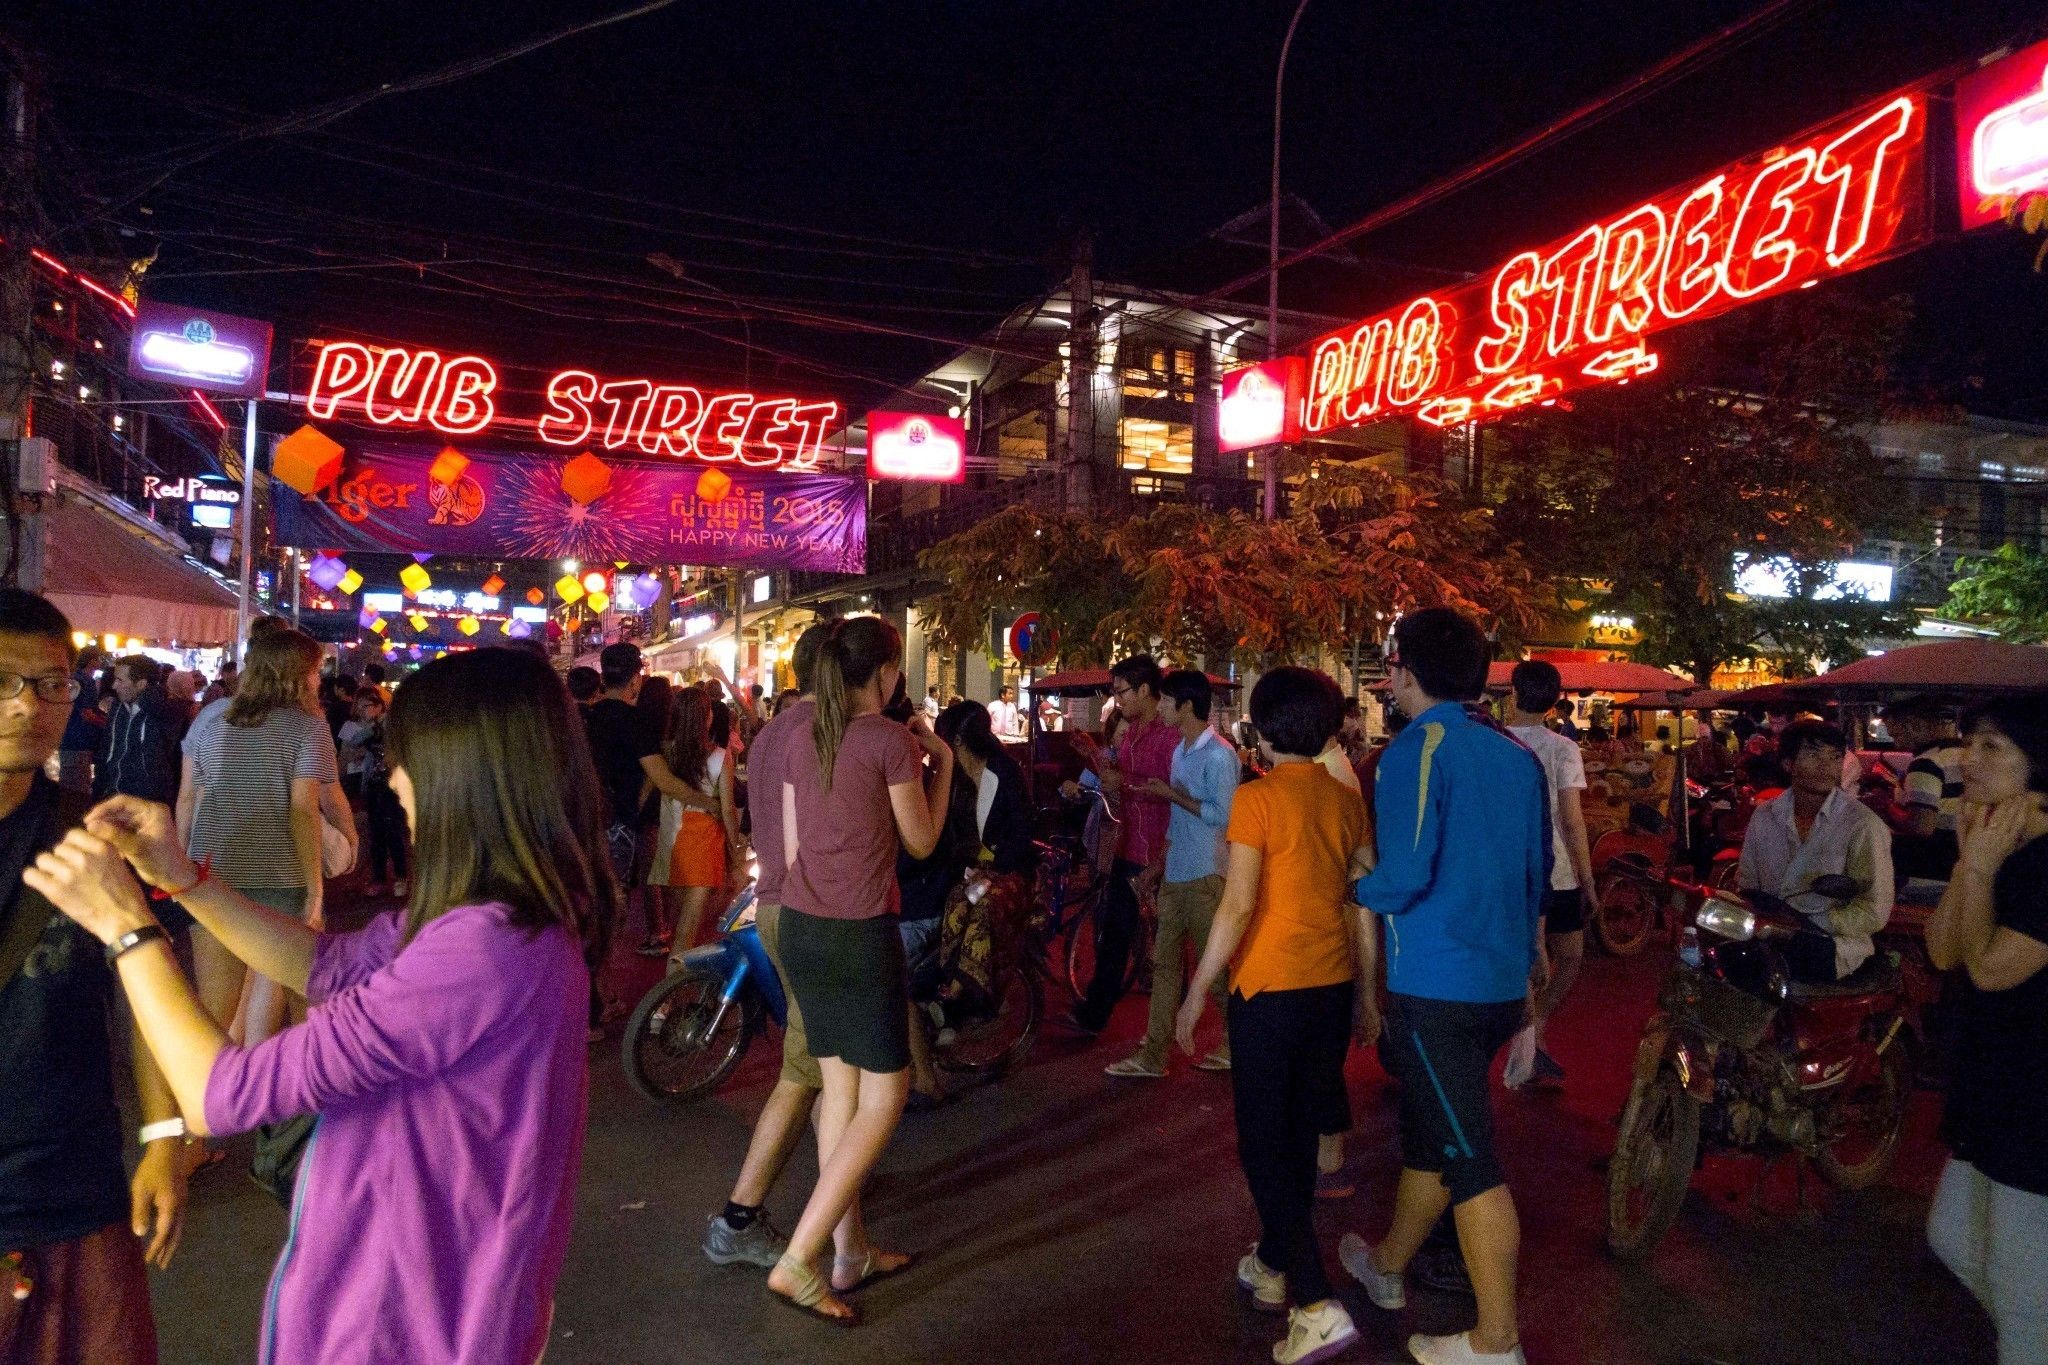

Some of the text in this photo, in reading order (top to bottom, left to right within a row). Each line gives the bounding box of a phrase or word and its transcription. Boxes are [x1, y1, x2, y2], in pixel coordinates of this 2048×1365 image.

[1306, 96, 1914, 432] PUB STREET
[308, 342, 499, 434] PUB
[537, 370, 839, 469] STREET
[144, 476, 240, 502] Red Piano
[670, 529, 846, 551] HAPPY NEW YEAR
